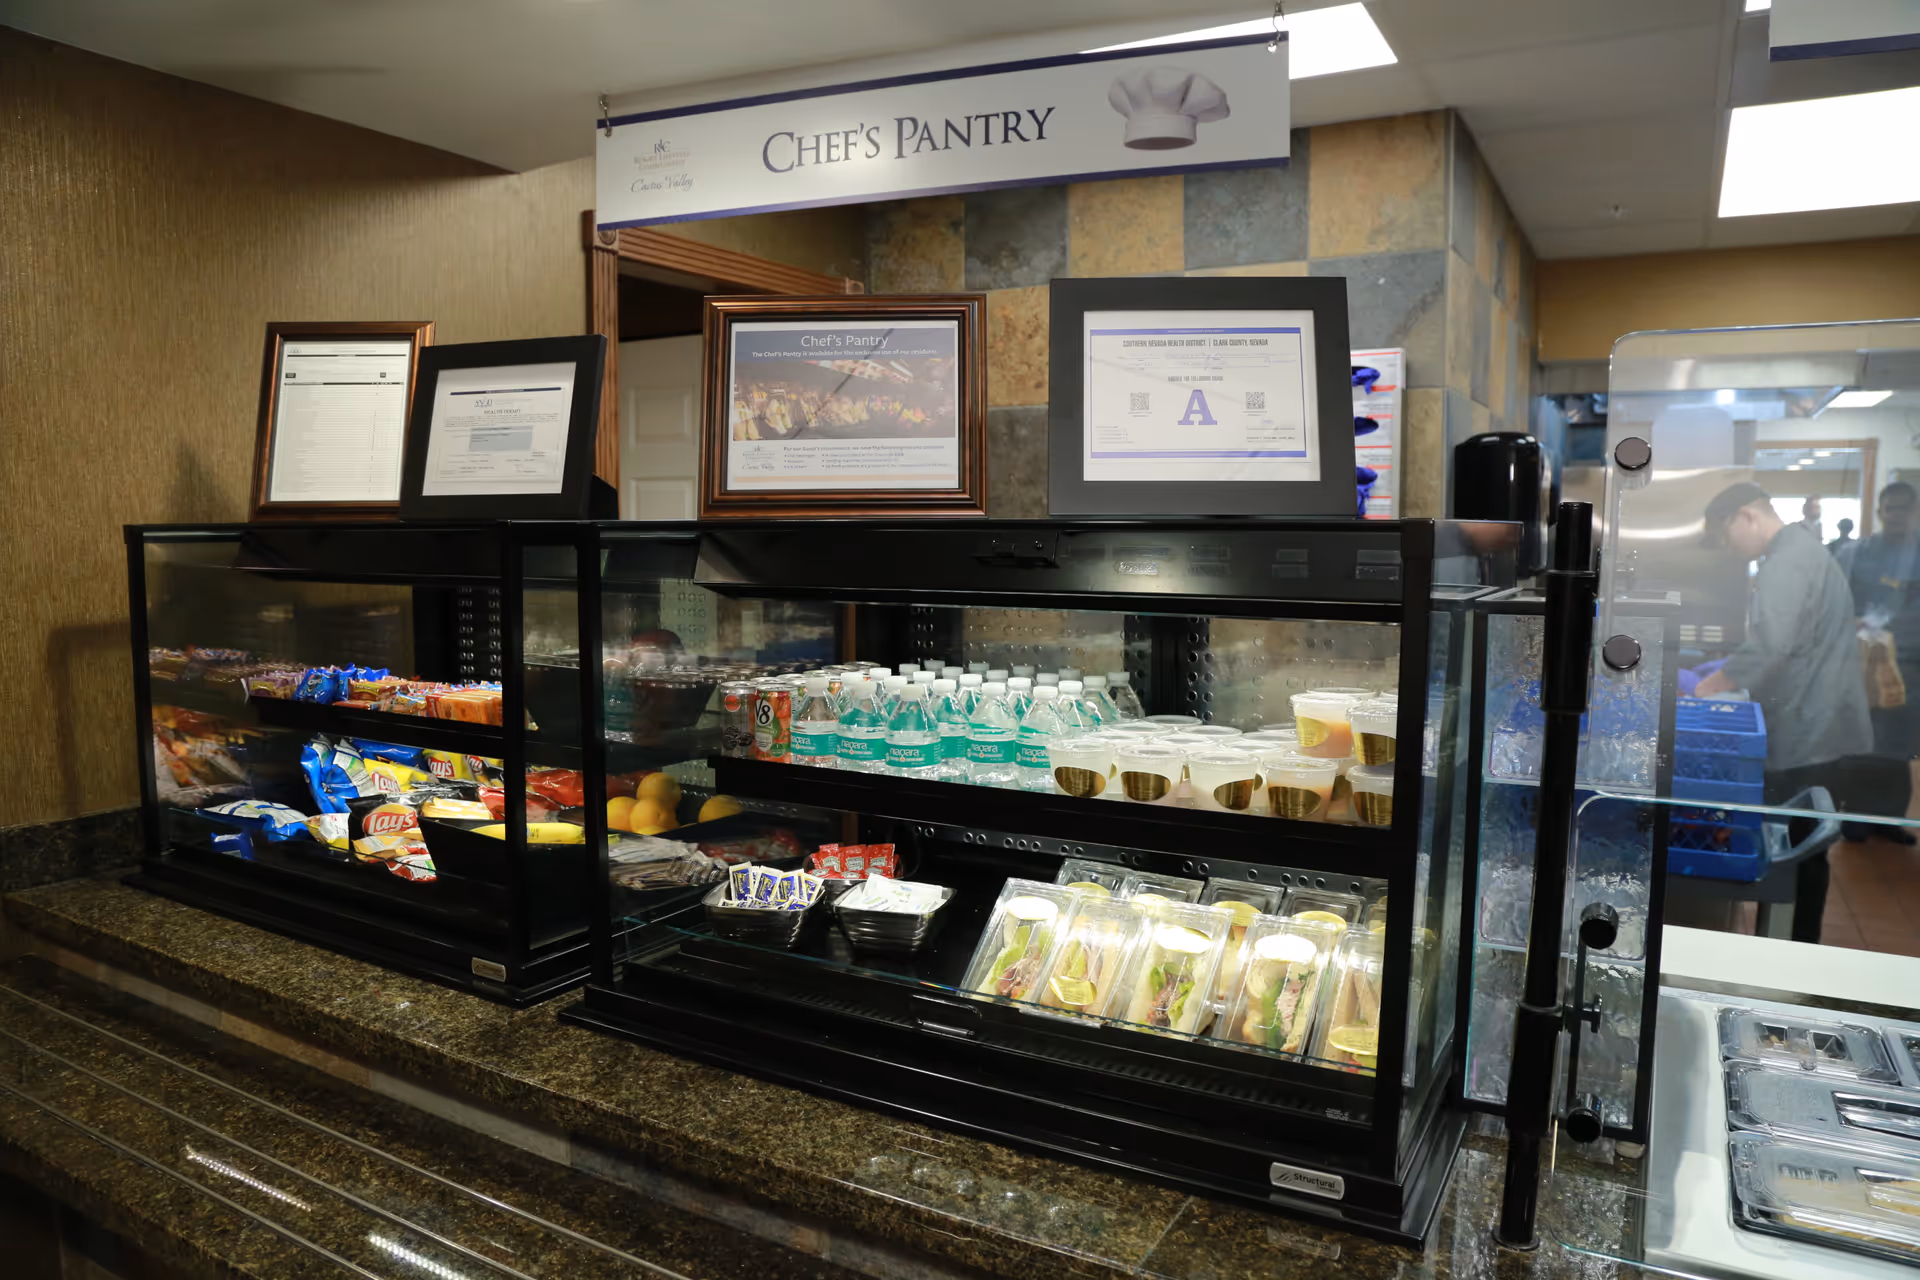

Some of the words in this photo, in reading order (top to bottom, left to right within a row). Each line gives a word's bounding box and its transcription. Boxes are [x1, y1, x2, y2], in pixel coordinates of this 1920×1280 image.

[762, 122, 881, 173] CHEF'S
[894, 107, 1056, 160] PANTRY
[665, 174, 694, 192] Valley
[801, 334, 841, 347] Chef's
[846, 335, 889, 349] Pantry
[1185, 339, 1206, 347] DISTRICT
[1250, 338, 1268, 346] NEVADA
[1177, 389, 1217, 425] A
[755, 698, 771, 725] V8
[841, 739, 867, 750] niagara
[889, 747, 920, 757] niagara
[971, 743, 998, 753] niagara
[1021, 747, 1049, 757] niagar
[428, 757, 453, 777] ay's
[368, 812, 414, 835] Lay's
[1293, 1172, 1336, 1188] Structural
